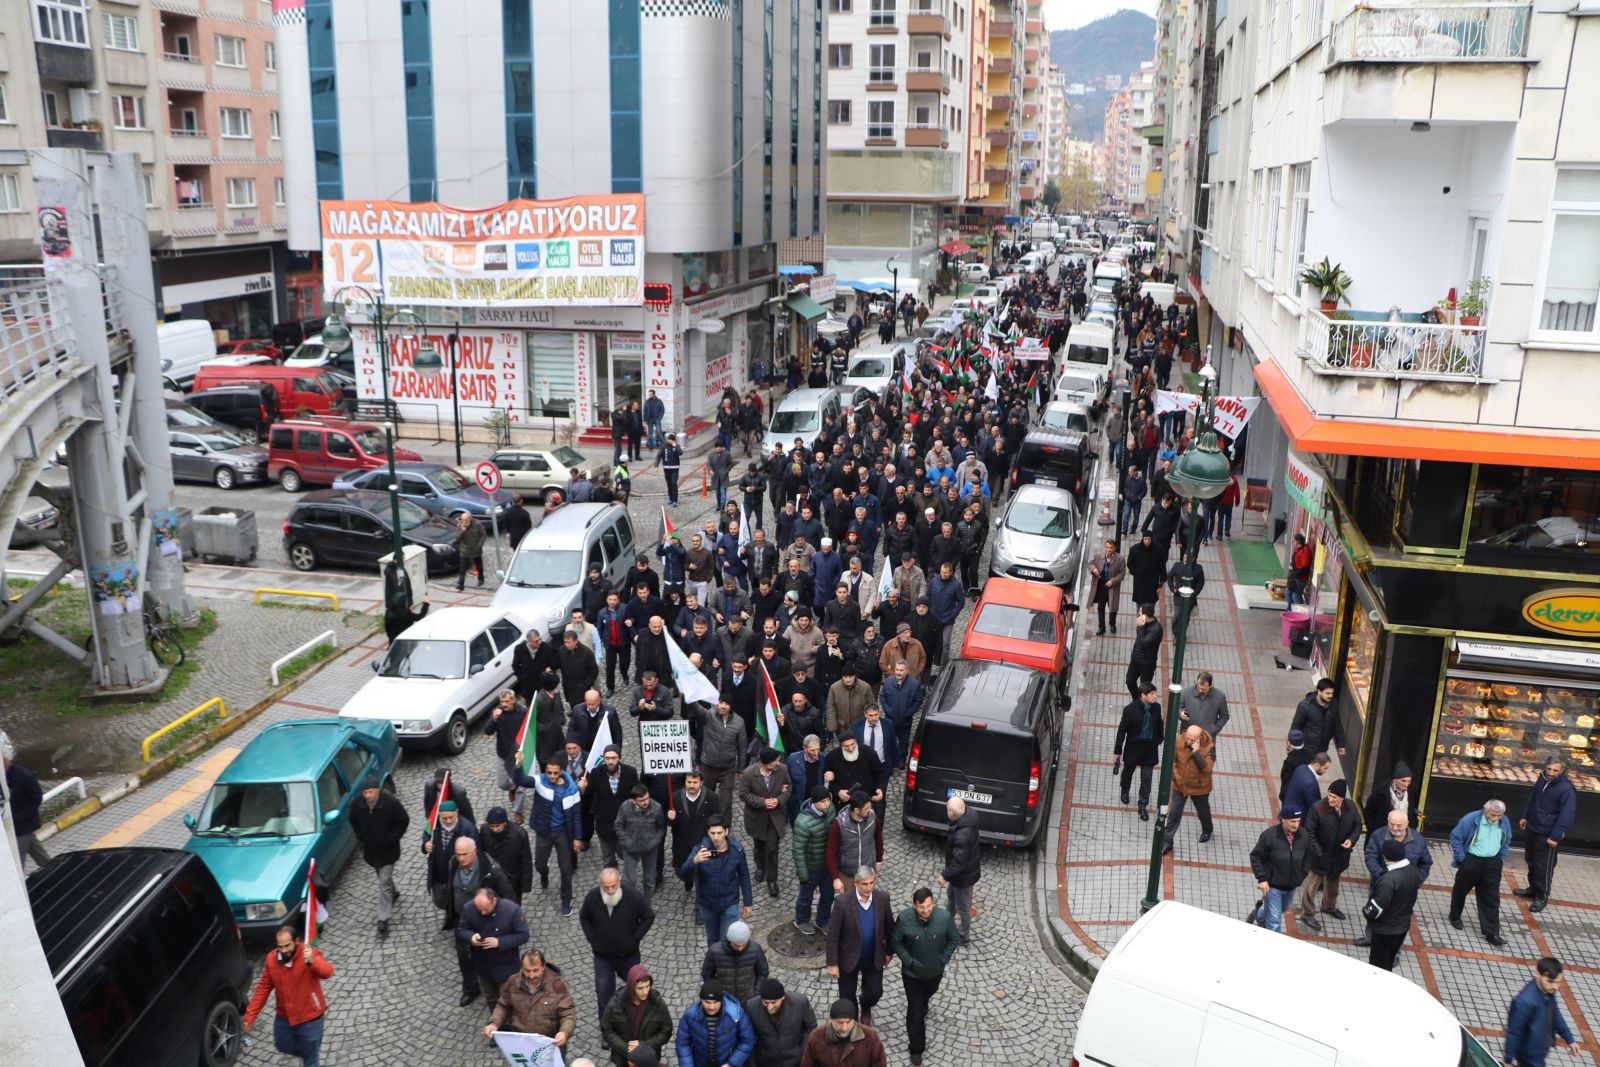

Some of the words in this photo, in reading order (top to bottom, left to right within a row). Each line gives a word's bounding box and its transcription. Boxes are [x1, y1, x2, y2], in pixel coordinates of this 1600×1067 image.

[329, 202, 467, 238] MAĞAZAMIZI
[473, 204, 637, 237] KAPATIYORUZ
[581, 243, 600, 254] OTEL
[613, 242, 633, 253] YURT
[330, 242, 375, 283] 12
[388, 276, 453, 299] ZARARINA
[546, 276, 638, 304] BAŞLAMIŞTIR
[479, 310, 518, 322] SARAY
[389, 333, 495, 370] KAPTIYORUZ
[459, 373, 497, 408] SATIŞ
[670, 723, 688, 737] SELAM
[644, 740, 688, 755] DİRENİŞE
[650, 759, 685, 770] DEVAM
[952, 789, 962, 797] 53
[964, 792, 975, 800] DN
[976, 793, 992, 802] 637
